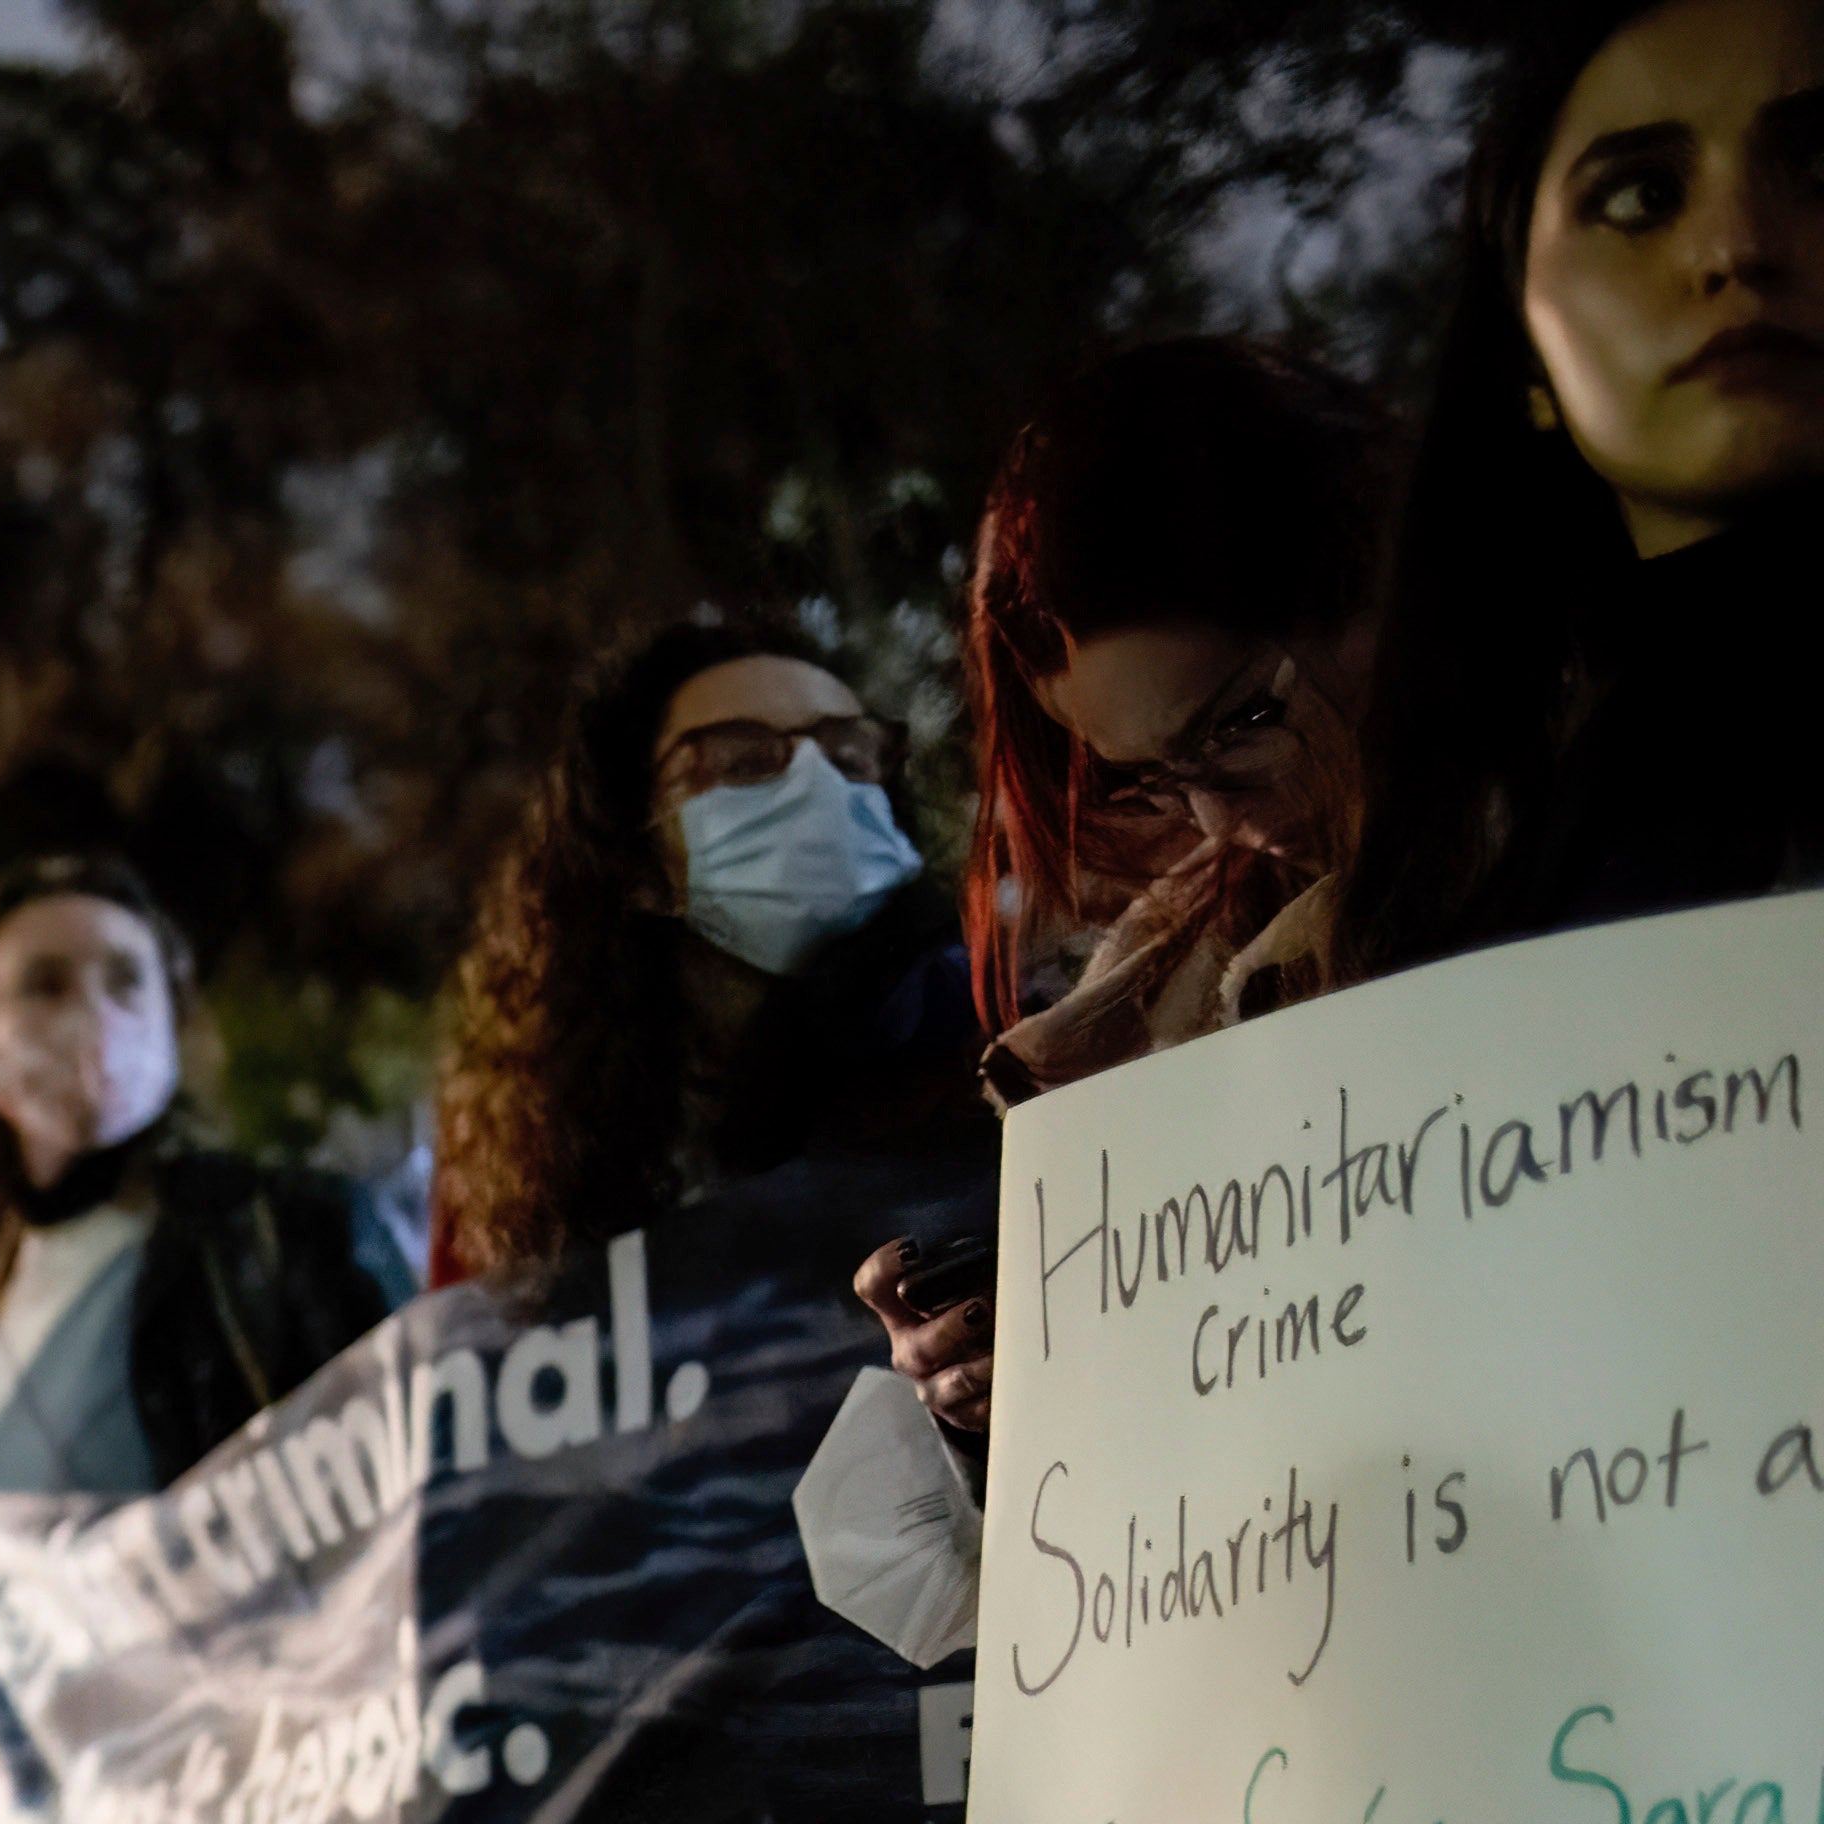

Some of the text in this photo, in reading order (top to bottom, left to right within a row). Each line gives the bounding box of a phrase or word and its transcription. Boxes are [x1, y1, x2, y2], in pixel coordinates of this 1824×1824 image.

[1012, 1408, 1824, 1697] Solidarity is not a
